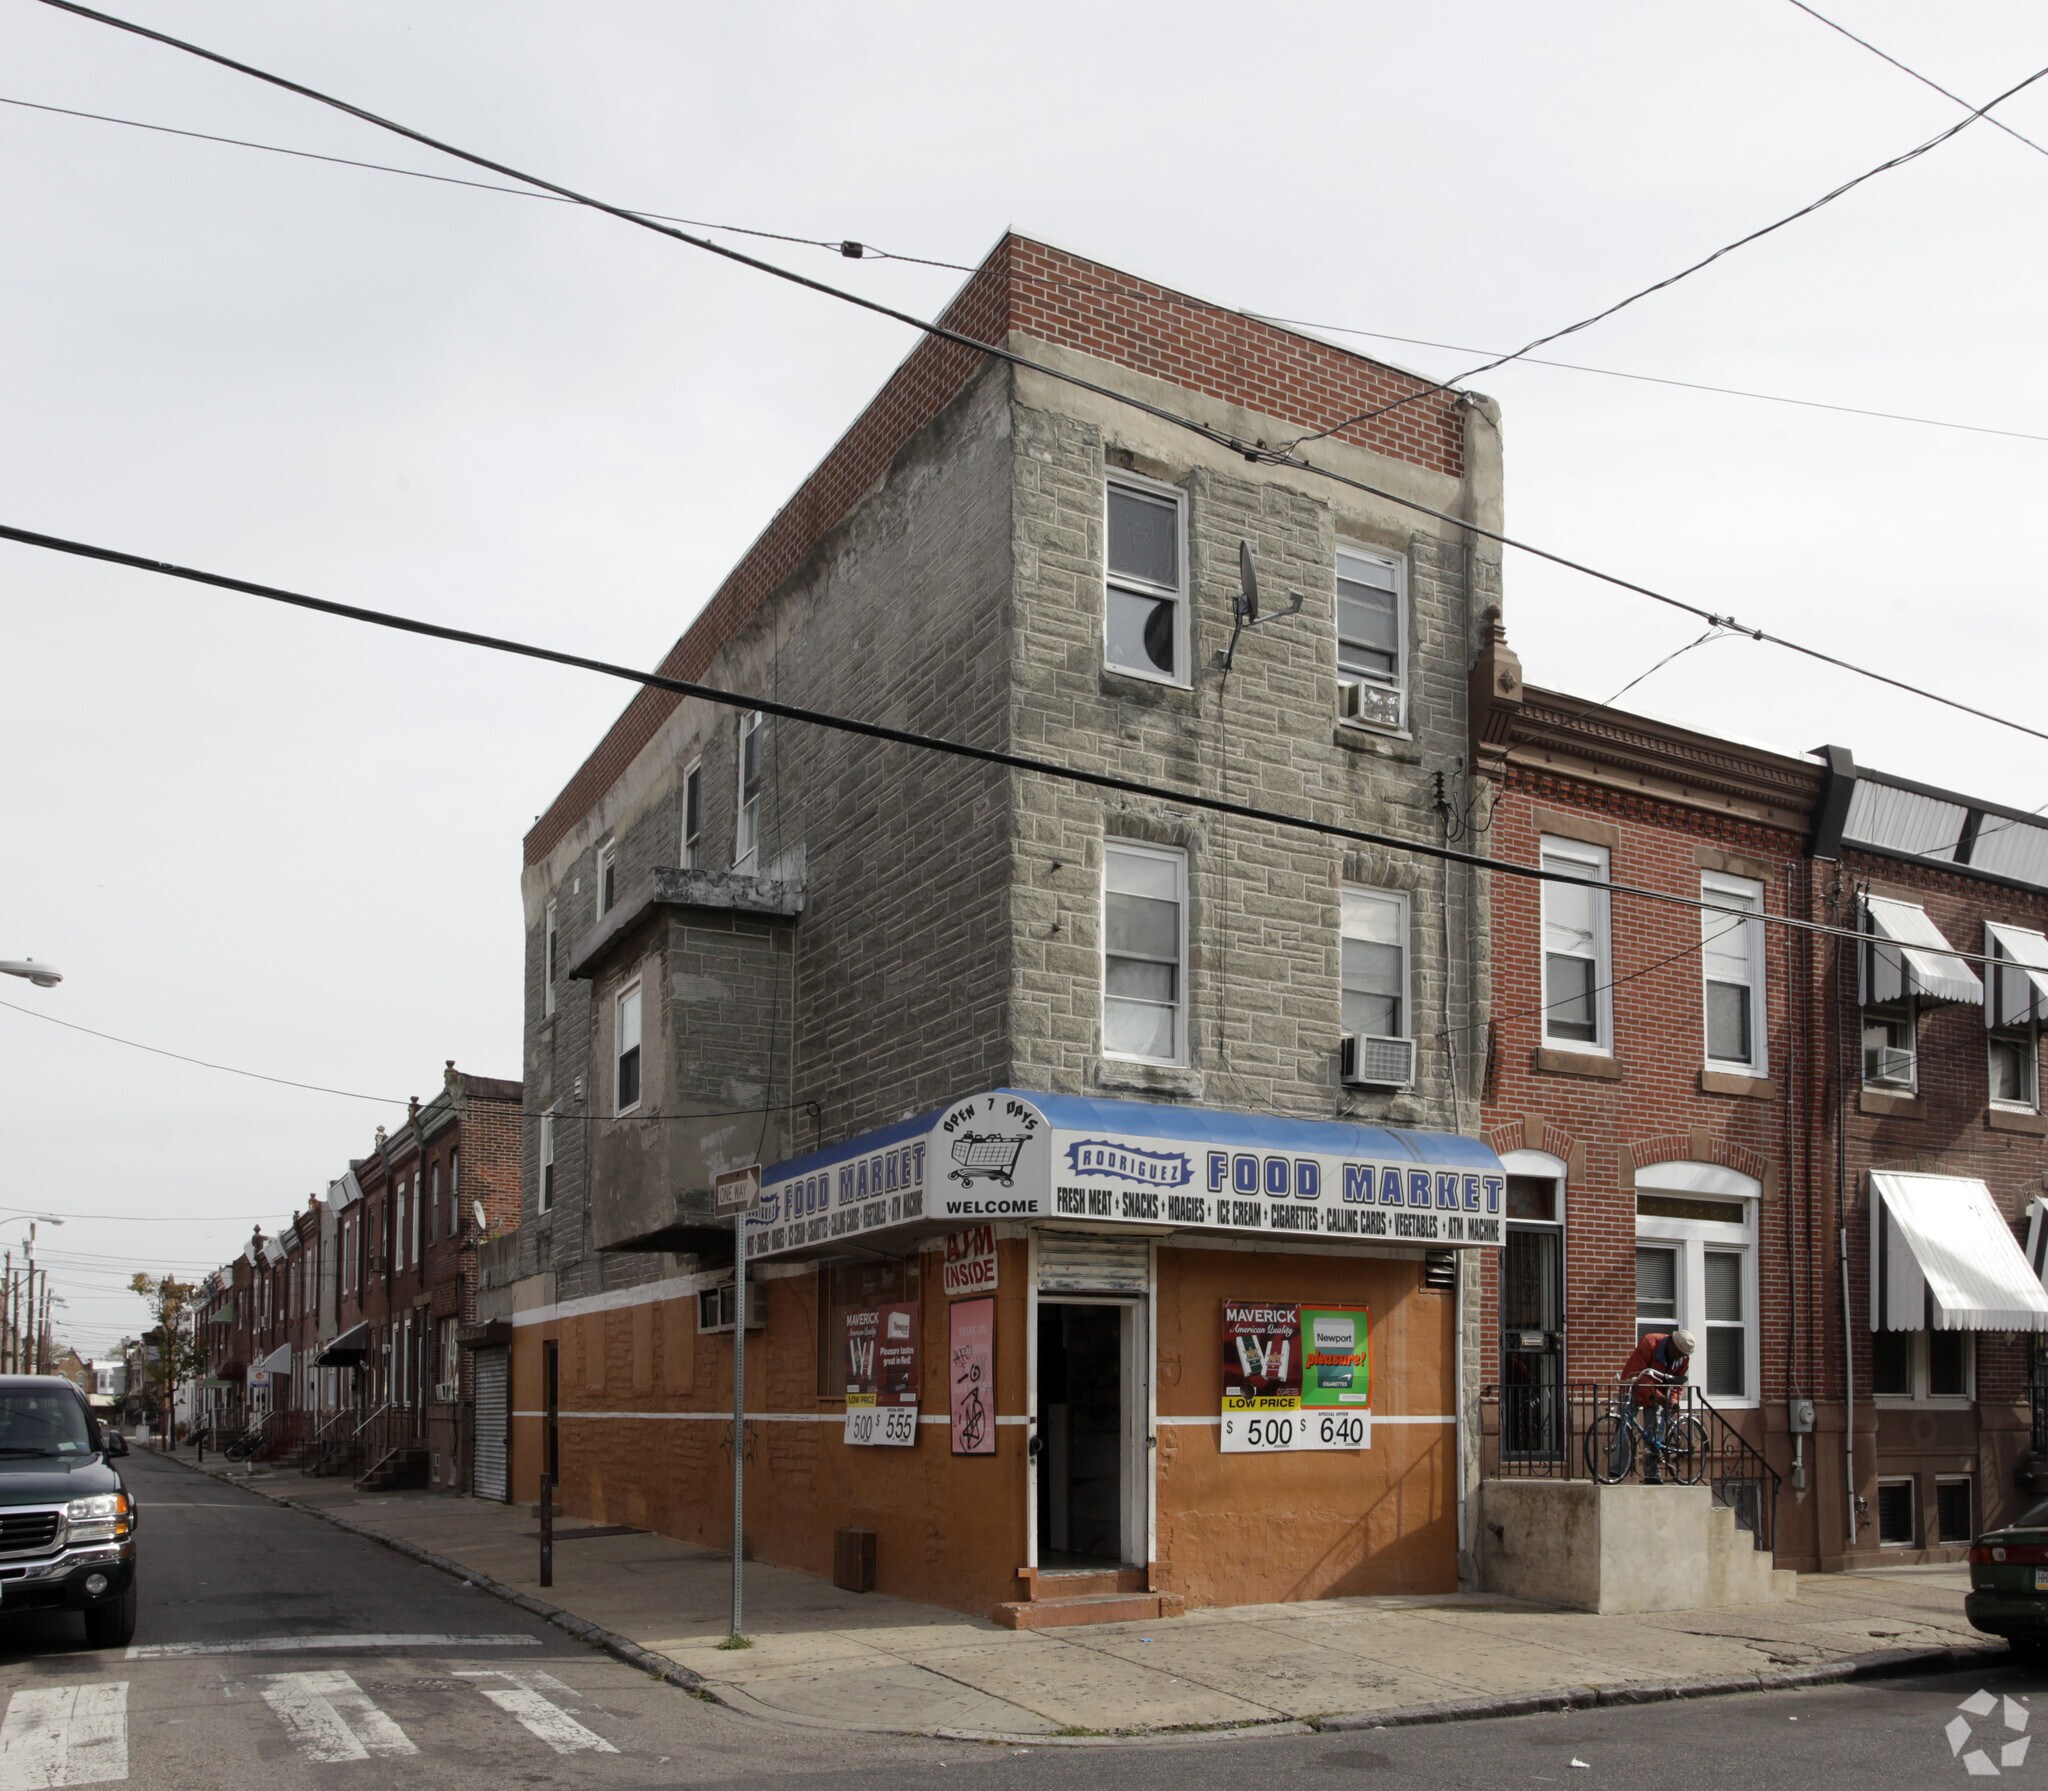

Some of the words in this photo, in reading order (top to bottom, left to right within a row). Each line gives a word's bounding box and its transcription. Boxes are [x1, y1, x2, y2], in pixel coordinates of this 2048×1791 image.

[944, 1104, 975, 1133] OPEN
[988, 1098, 994, 1110] 7
[1006, 1101, 1038, 1130] DAYS
[1083, 1150, 1178, 1180] RODRIGUEZ
[784, 1173, 829, 1222] FOOD
[839, 1141, 926, 1206] MARKET
[1206, 1150, 1320, 1200] FOOD
[1342, 1162, 1504, 1214] MARKET
[720, 1186, 732, 1203] ONE
[734, 1182, 747, 1200] WAY
[946, 1200, 1038, 1214] WELCOME
[1057, 1187, 1086, 1214] FRESH
[1088, 1189, 1112, 1216] MEAT
[1122, 1192, 1158, 1220] SNACKS
[1168, 1195, 1205, 1223] HOAGIES
[1217, 1199, 1230, 1224] ICE
[1232, 1201, 1261, 1227] CREAM
[1271, 1204, 1318, 1231] CIGARETTES
[1326, 1208, 1358, 1233] CALLING
[1360, 1210, 1386, 1235] CARDS
[1394, 1212, 1438, 1238] VEGETABLES
[1448, 1216, 1464, 1240] ATM
[1468, 1218, 1499, 1242] MACHINE
[946, 1225, 994, 1262] ATM
[945, 1258, 994, 1288] INSIDE
[847, 1312, 879, 1326] MAVERICK
[1226, 1308, 1296, 1323] MAVERICK
[1230, 1324, 1266, 1334] American
[1266, 1324, 1293, 1336] Quality
[1317, 1333, 1352, 1344] Newport
[880, 1347, 900, 1356] Pleasure
[900, 1346, 914, 1354] tastes
[883, 1357, 896, 1367] great
[1306, 1350, 1366, 1368] pleasure!
[849, 1395, 859, 1404] LOW
[860, 1395, 874, 1404] PRICE
[1229, 1399, 1256, 1408] LOW
[1260, 1398, 1295, 1407] PRICE
[876, 1414, 880, 1427] $
[1226, 1420, 1233, 1434] $
[1300, 1418, 1306, 1432] $
